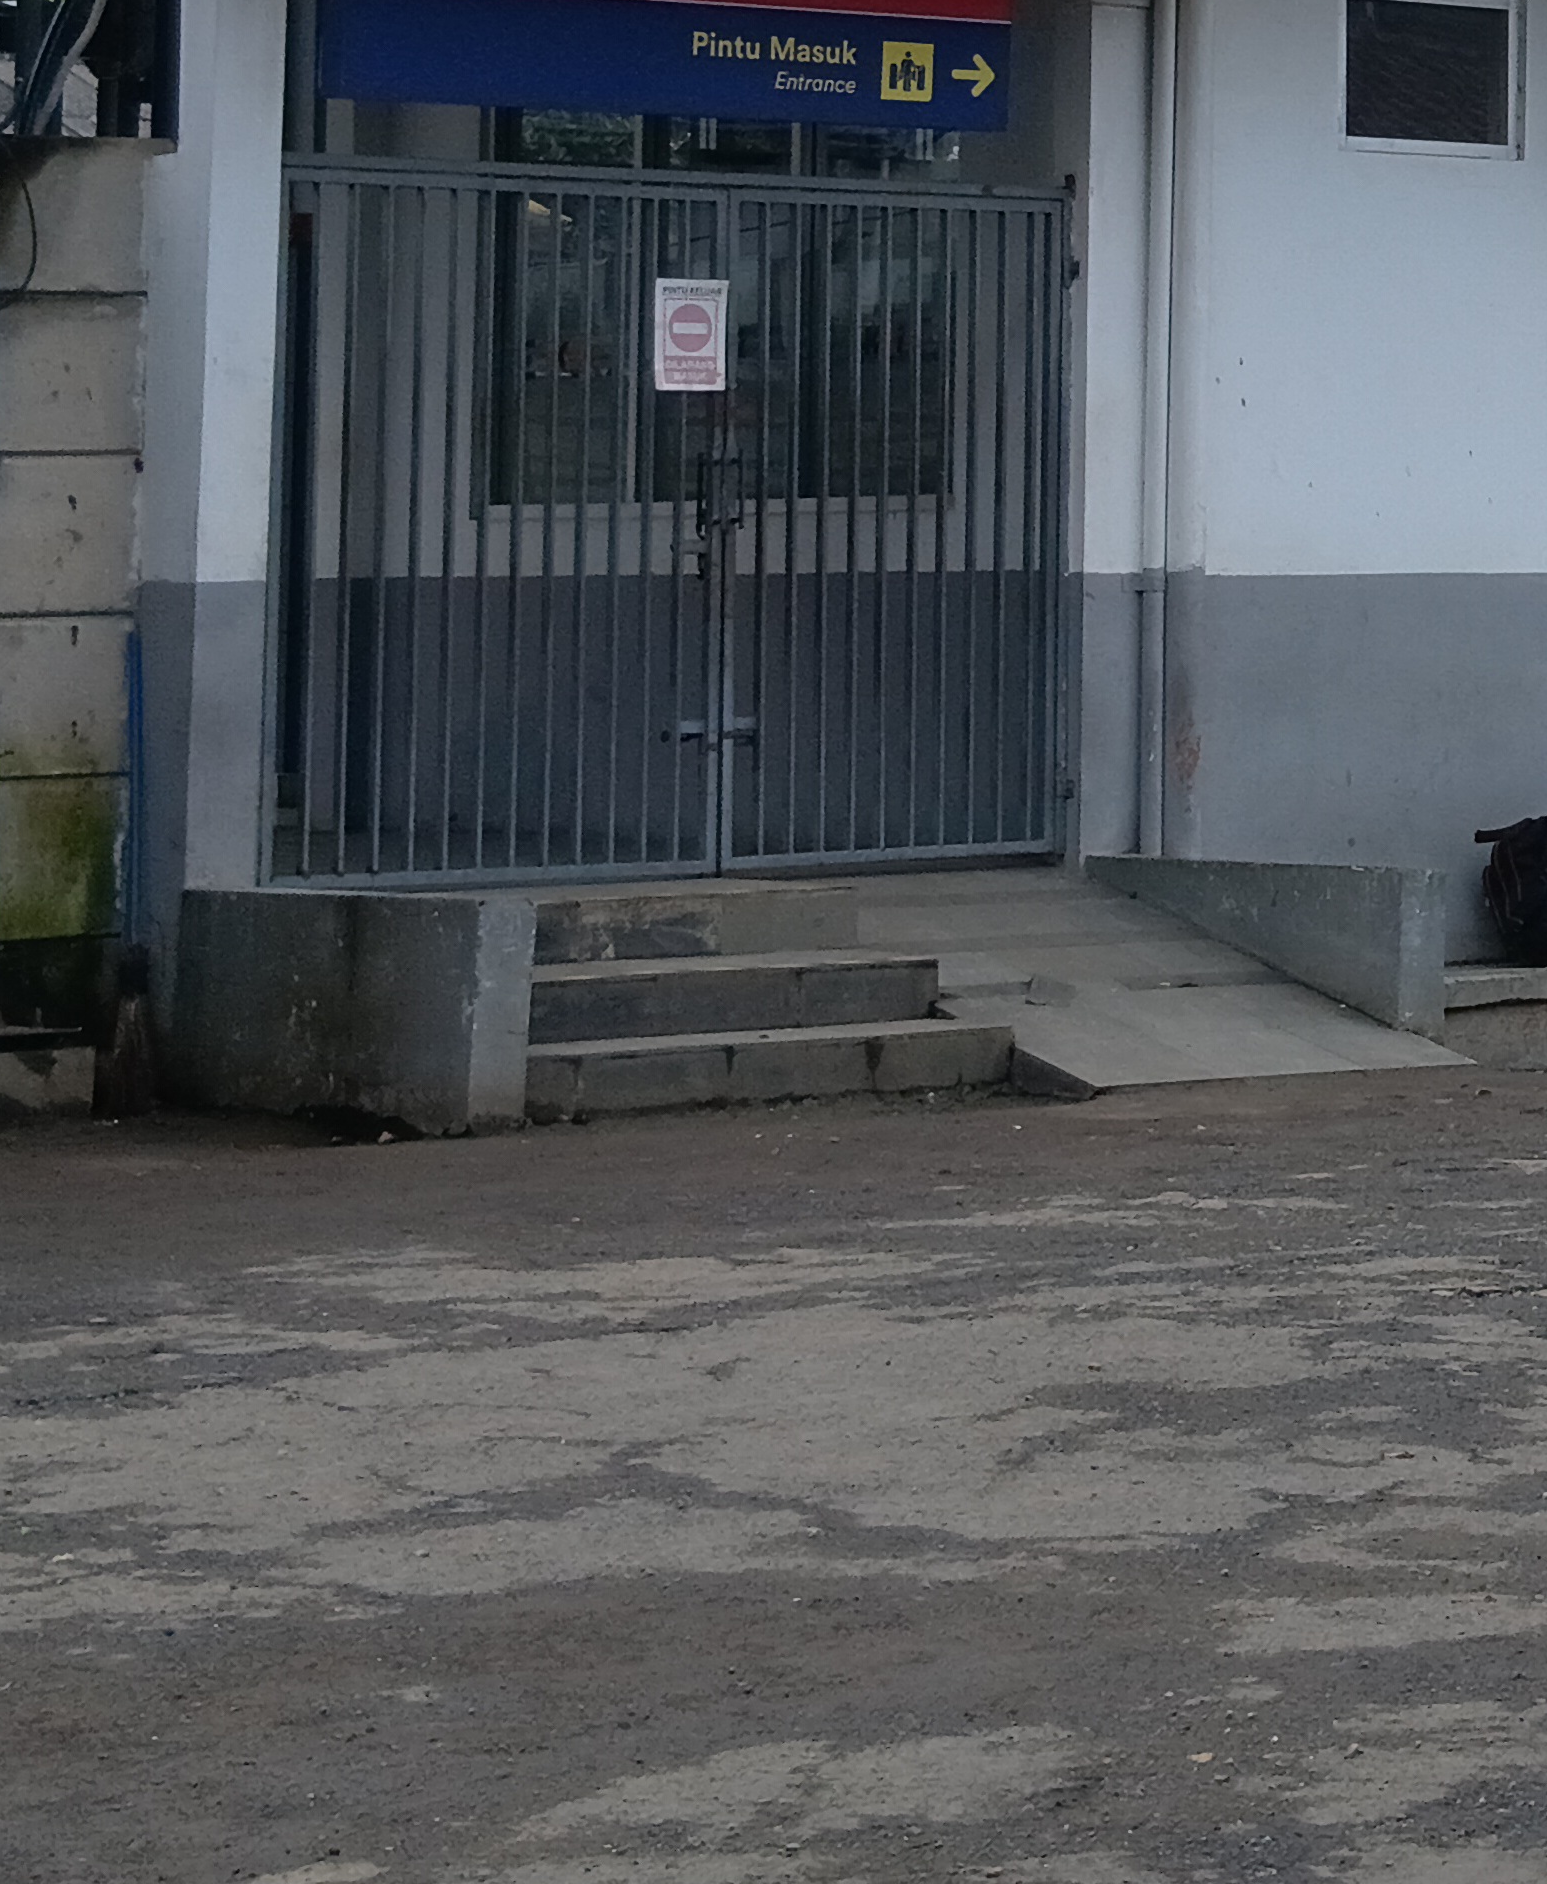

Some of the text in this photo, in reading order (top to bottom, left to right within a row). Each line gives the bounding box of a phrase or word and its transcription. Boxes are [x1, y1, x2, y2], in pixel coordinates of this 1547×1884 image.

[692, 31, 857, 65] Pintu Masuk
[774, 71, 856, 94] Entrance
